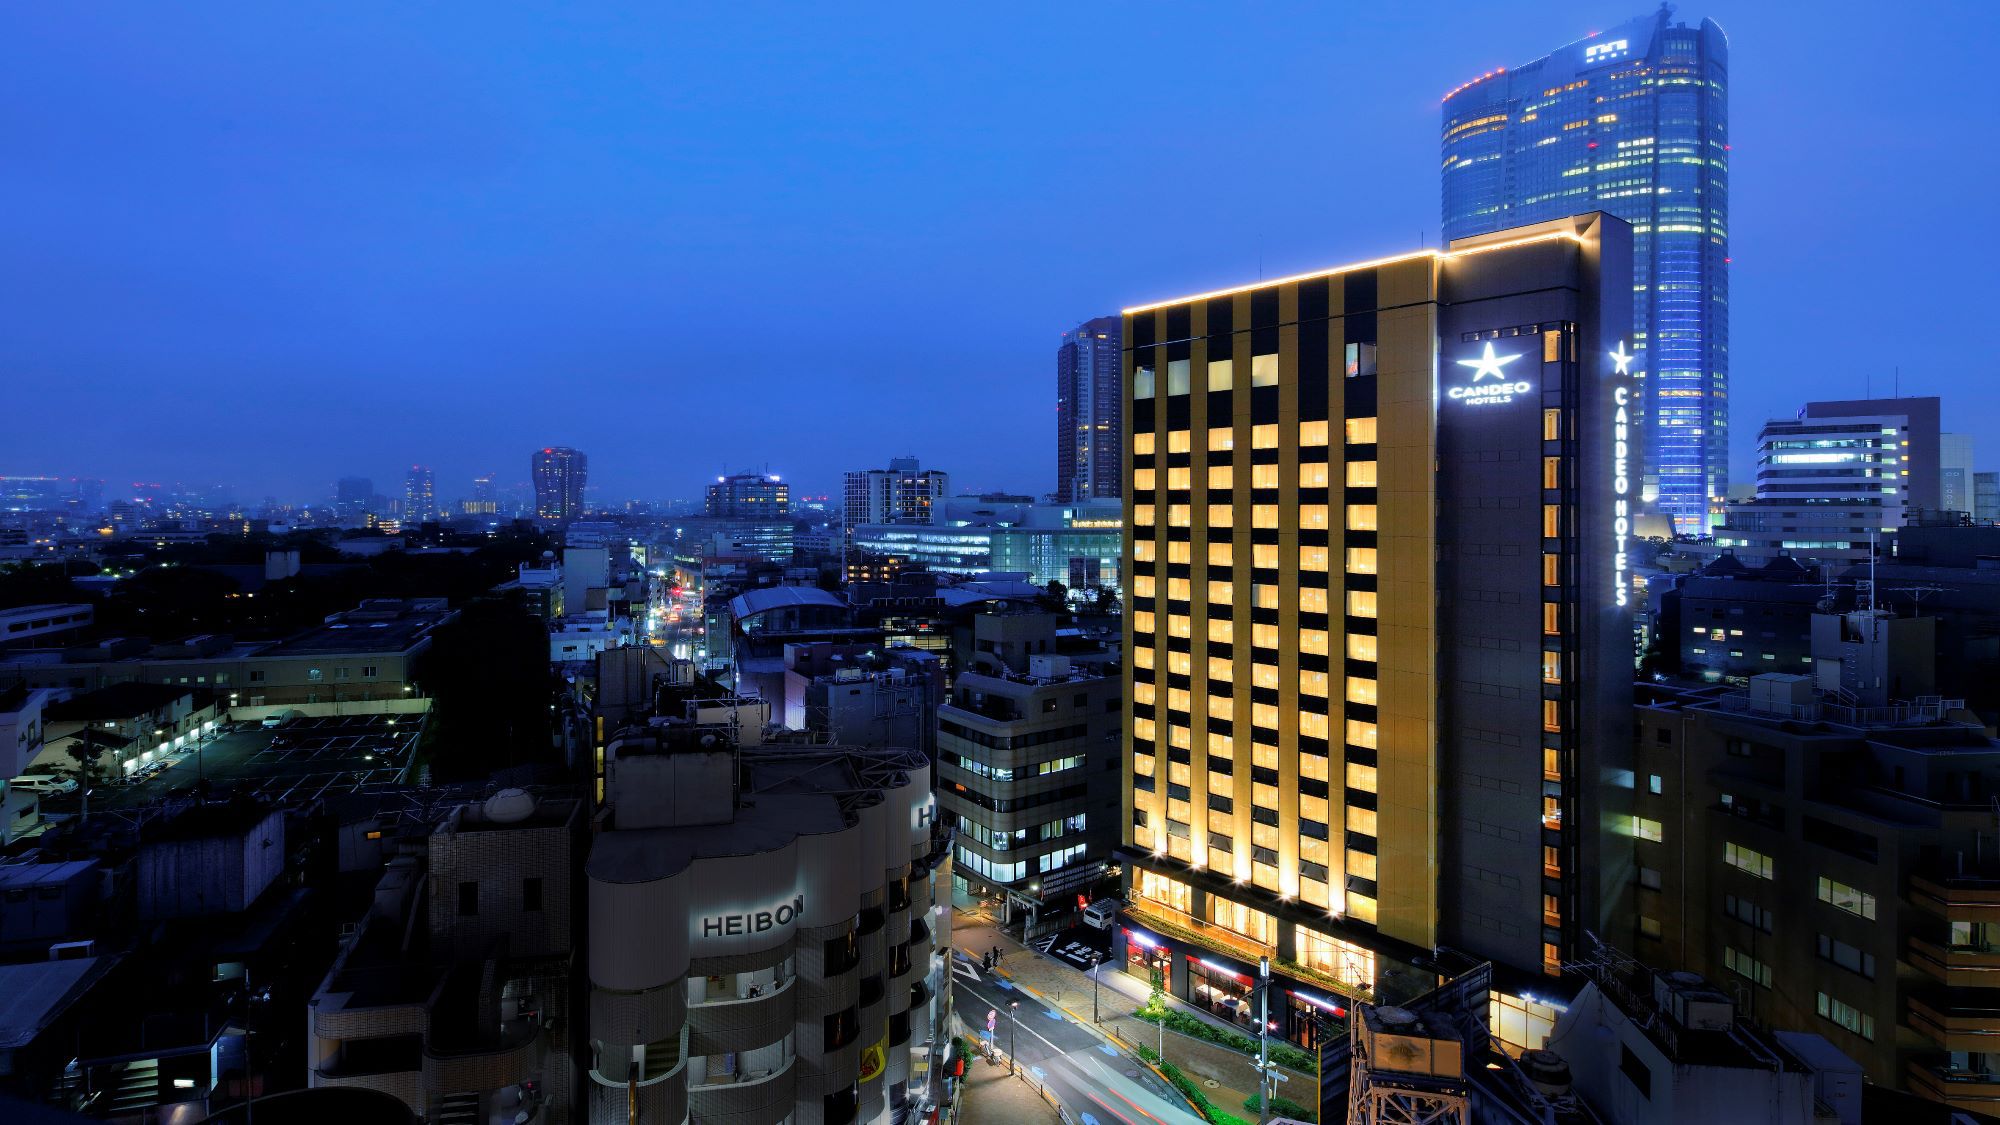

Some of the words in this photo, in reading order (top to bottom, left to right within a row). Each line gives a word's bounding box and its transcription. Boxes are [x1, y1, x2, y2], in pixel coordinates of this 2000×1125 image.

[1448, 381, 1530, 399] CANDEO
[1465, 395, 1512, 405] HOTELS
[1614, 387, 1628, 494] CANDEO
[1614, 500, 1628, 606] HOTELS
[703, 894, 804, 938] HEIBON
